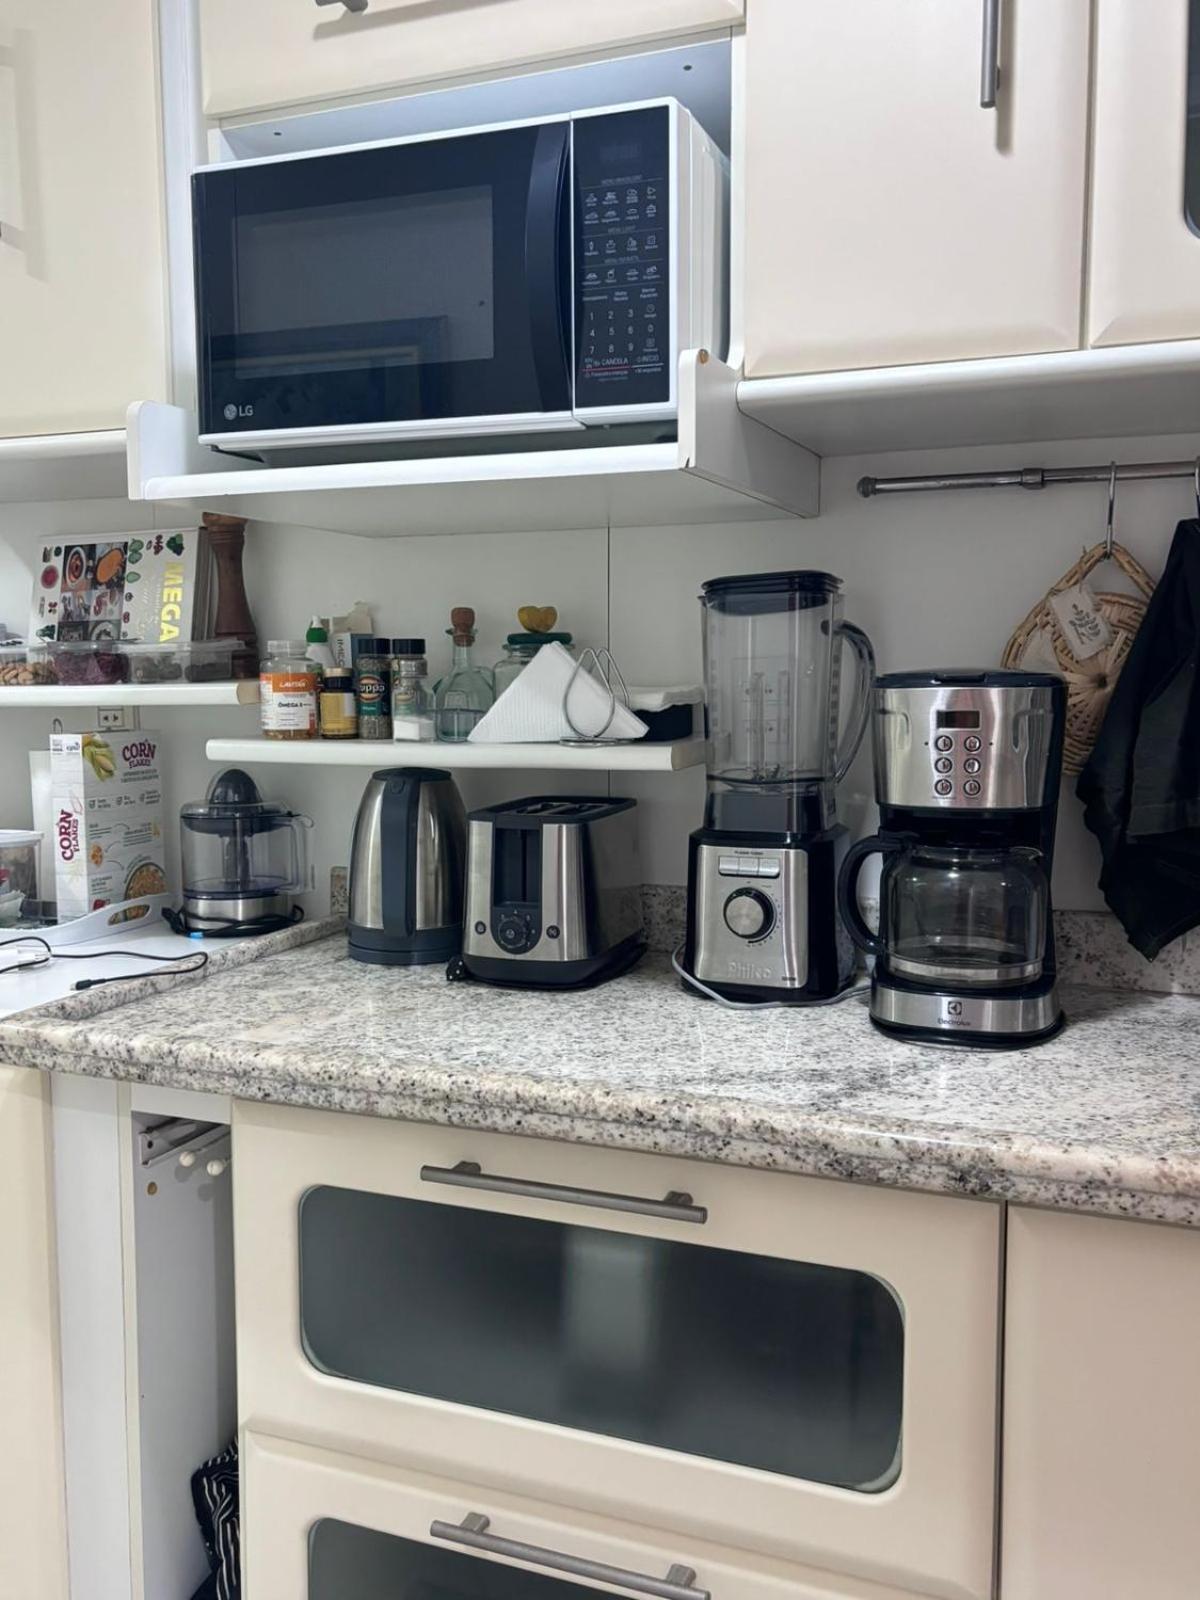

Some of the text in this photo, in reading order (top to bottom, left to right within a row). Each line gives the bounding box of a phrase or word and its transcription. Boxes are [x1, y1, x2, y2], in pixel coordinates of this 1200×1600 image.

[239, 405, 254, 416] LG
[160, 562, 185, 643] MEGA
[122, 741, 156, 762] CORN
[129, 759, 152, 769] FLAKES
[58, 809, 74, 861] CORN
[72, 818, 80, 853] FLAKES
[937, 1017, 971, 1026] Electrolux
